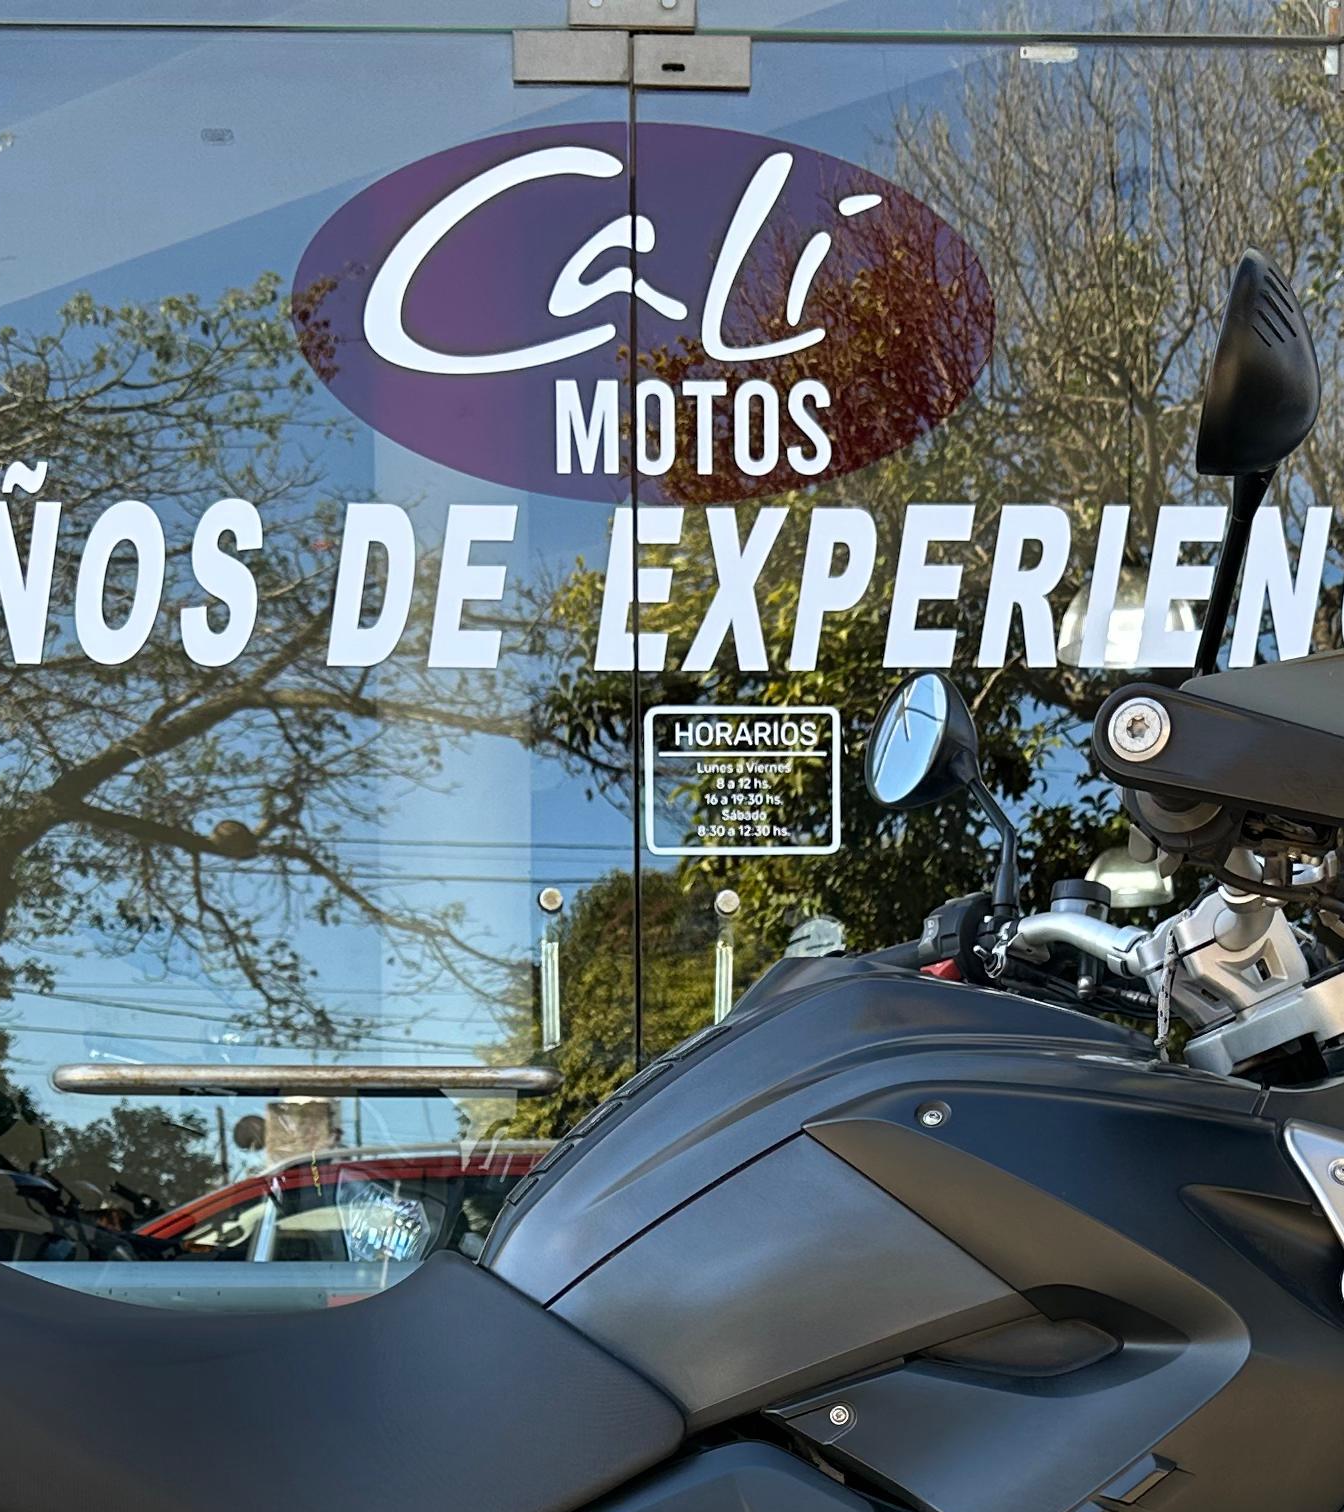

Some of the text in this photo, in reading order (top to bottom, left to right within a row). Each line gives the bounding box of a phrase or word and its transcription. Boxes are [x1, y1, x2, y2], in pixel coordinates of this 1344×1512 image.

[556, 379, 832, 476] MOTOS
[326, 502, 518, 669] DE
[674, 721, 818, 746] HORARIOS
[697, 762, 792, 774] Lunes a Viernes
[716, 778, 772, 790] 8 a 12 hs.
[704, 794, 784, 805] 16 a 19:30 hs.
[721, 809, 767, 821] Sábado
[697, 825, 791, 837] 8:30 a 12:30 hs.
